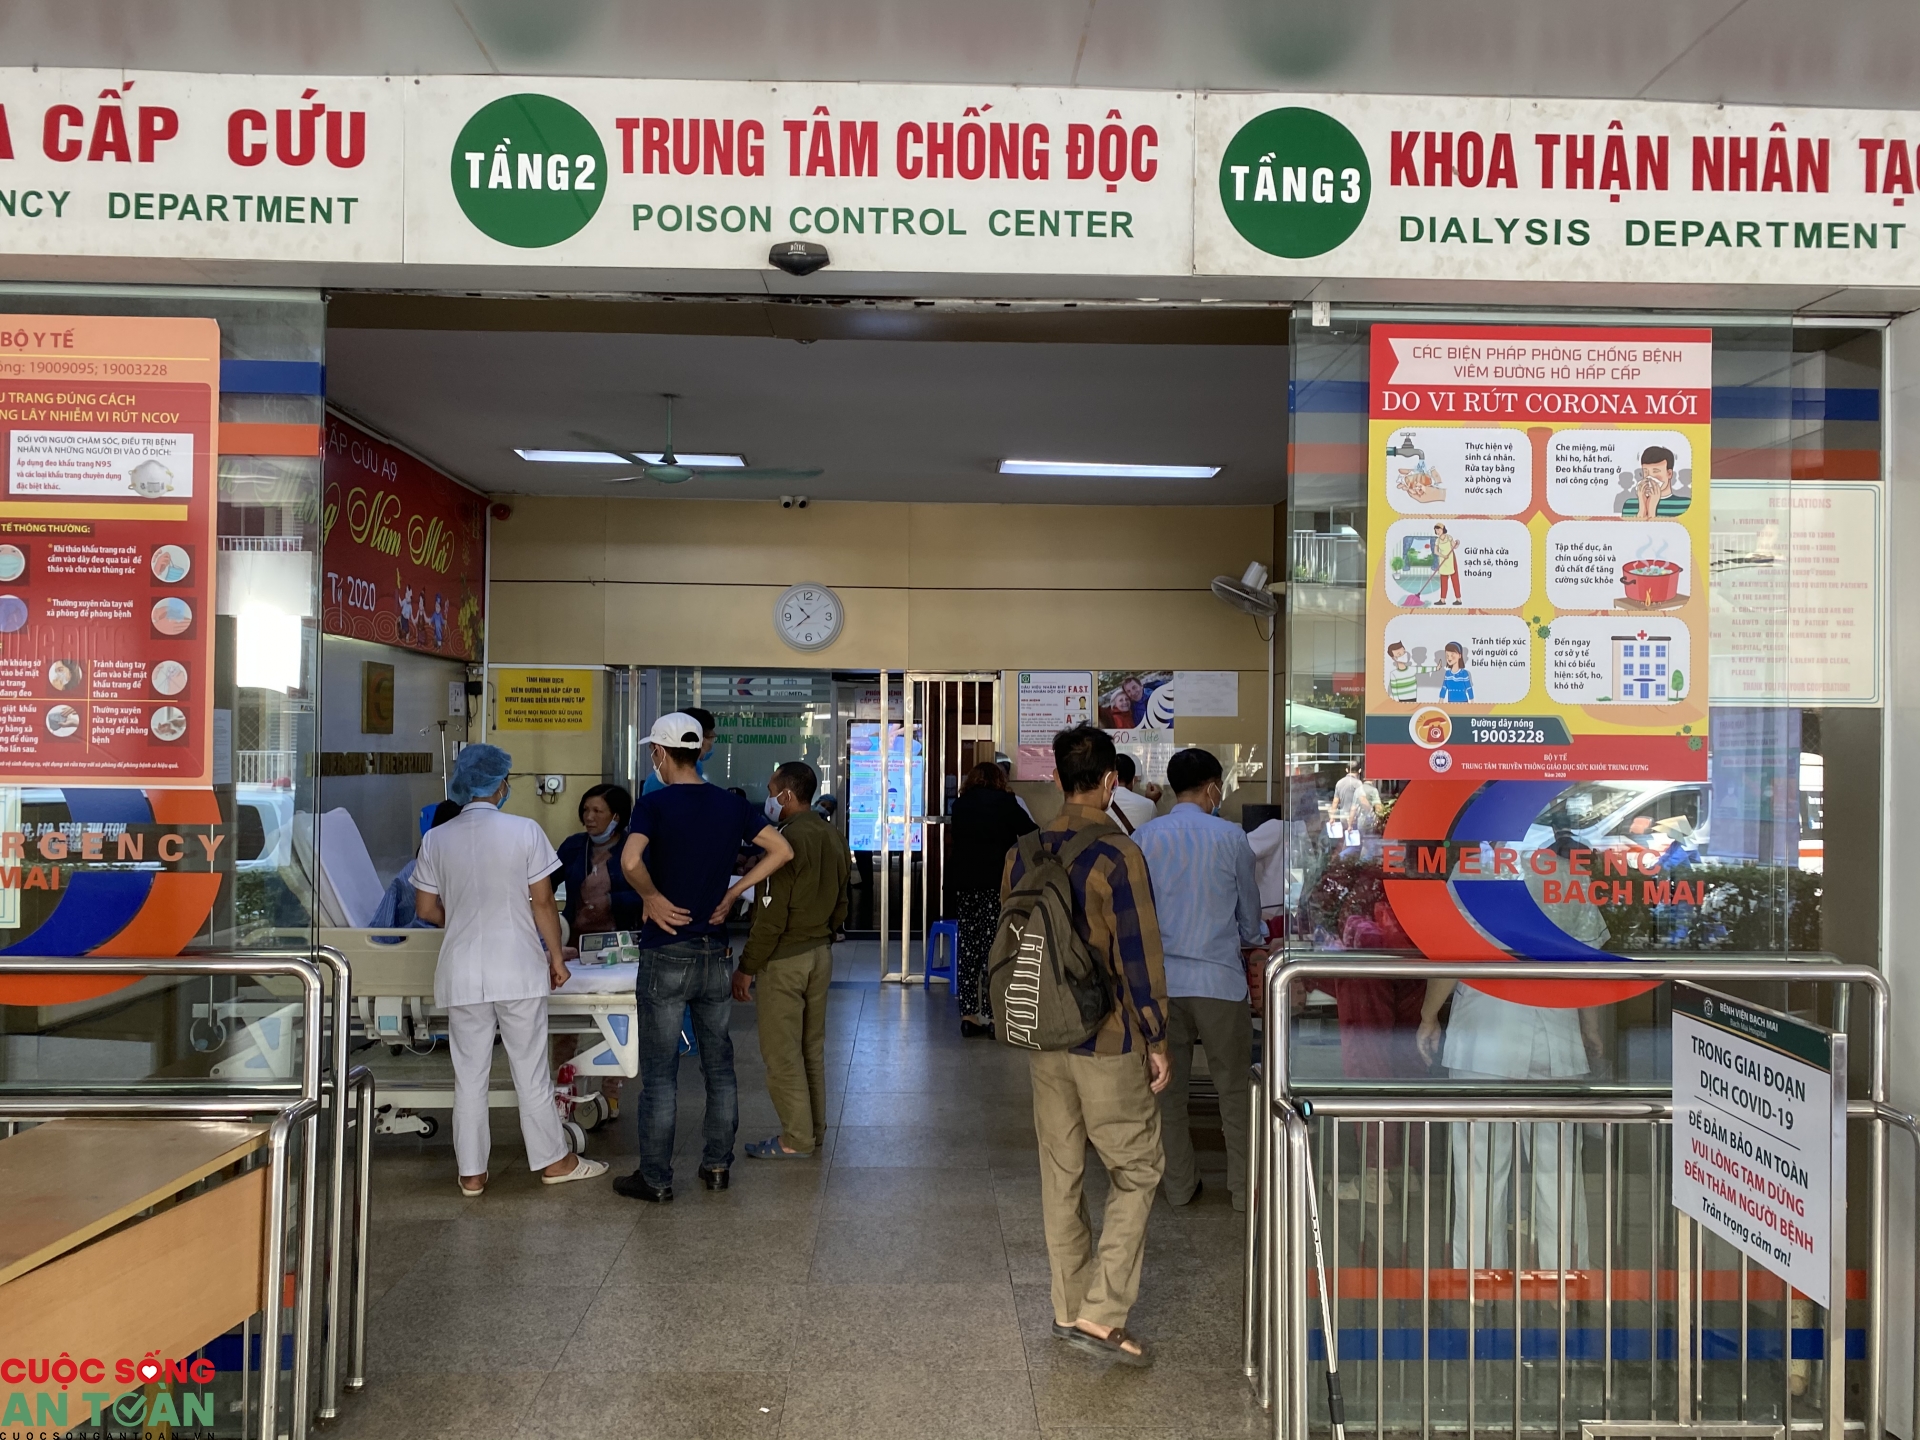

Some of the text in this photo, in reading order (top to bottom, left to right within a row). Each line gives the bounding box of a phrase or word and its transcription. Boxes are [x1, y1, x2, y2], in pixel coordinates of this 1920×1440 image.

[42, 81, 179, 163] CẤP
[228, 88, 366, 169] CỨU
[616, 103, 1158, 194] TRUNG TÂM CHỐNG ĐỘC
[465, 138, 596, 192] TẦNG2
[1390, 119, 1920, 207] KHOA THẬN NHÂN TẠ
[1230, 151, 1363, 203] TẦNG3
[108, 192, 359, 225] DEPARTMENT
[632, 204, 1134, 238] POISON CONTROL CENTER
[1400, 216, 1907, 249] DIALYSIS DEPARTMENT
[1, 328, 75, 351] BỘ Y TẾ
[1413, 344, 1682, 364] CÁC BIỆN PHÁP PHÒNG CHỐNG BỆNH
[30, 362, 98, 376] 19009095;
[103, 363, 167, 376] 19003228
[1454, 364, 1640, 380] VIÊM ĐƯỜNG HÔ HẤP CẤP
[8, 392, 54, 404] TRANG
[56, 391, 96, 405] ĐÚNG
[99, 393, 136, 406] CÁCH
[1382, 388, 1698, 415] DO VI RÚT CORONA MỚI
[21, 408, 46, 421] LÂY
[50, 407, 93, 422] NHIỄM
[97, 411, 109, 422] VI
[113, 410, 139, 423] RÚT
[141, 412, 179, 424] NCOV
[351, 441, 378, 473] CỨU
[382, 458, 398, 482] A9
[1465, 453, 1481, 461] sinh
[1493, 453, 1515, 461] nhân.
[1555, 454, 1613, 464] khi ho, hắt hơi.
[1465, 475, 1512, 484] xà phòng và
[1465, 486, 1502, 495] nước sạch
[1769, 498, 1832, 508] REGULATIONS
[1, 522, 91, 533] TẾ THÔNG THƯỜNG:
[1464, 570, 1492, 578] thoáng
[327, 572, 376, 629] Tý 2020
[803, 592, 813, 600] 12
[784, 613, 792, 621] 9
[825, 612, 832, 621] 3
[805, 633, 812, 642] 6
[1471, 719, 1534, 730] Đường dây nóng
[1472, 729, 1545, 744] 19003228
[737, 734, 786, 744] COMMAND
[2, 832, 225, 862] RGENCY
[0, 866, 59, 890] MAI
[1543, 880, 1704, 905] BACH MAI
[1720, 1003, 1778, 1032] BỆNH VIỆN BẠCH MAI
[1691, 1035, 1805, 1102] TRONG GIAI ĐOẠN
[1700, 1070, 1794, 1130] DỊCH COVID-19
[1689, 1110, 1809, 1189] ĐỂ ĐẢM BẢO AN TOÀN
[1691, 1137, 1804, 1217] VUI LÒNG TẠM DỪNG
[1685, 1160, 1813, 1254] ĐẾN THĂM NGƯỜI BỆNH
[1702, 1197, 1792, 1267] Trân trọng cảm ơn!
